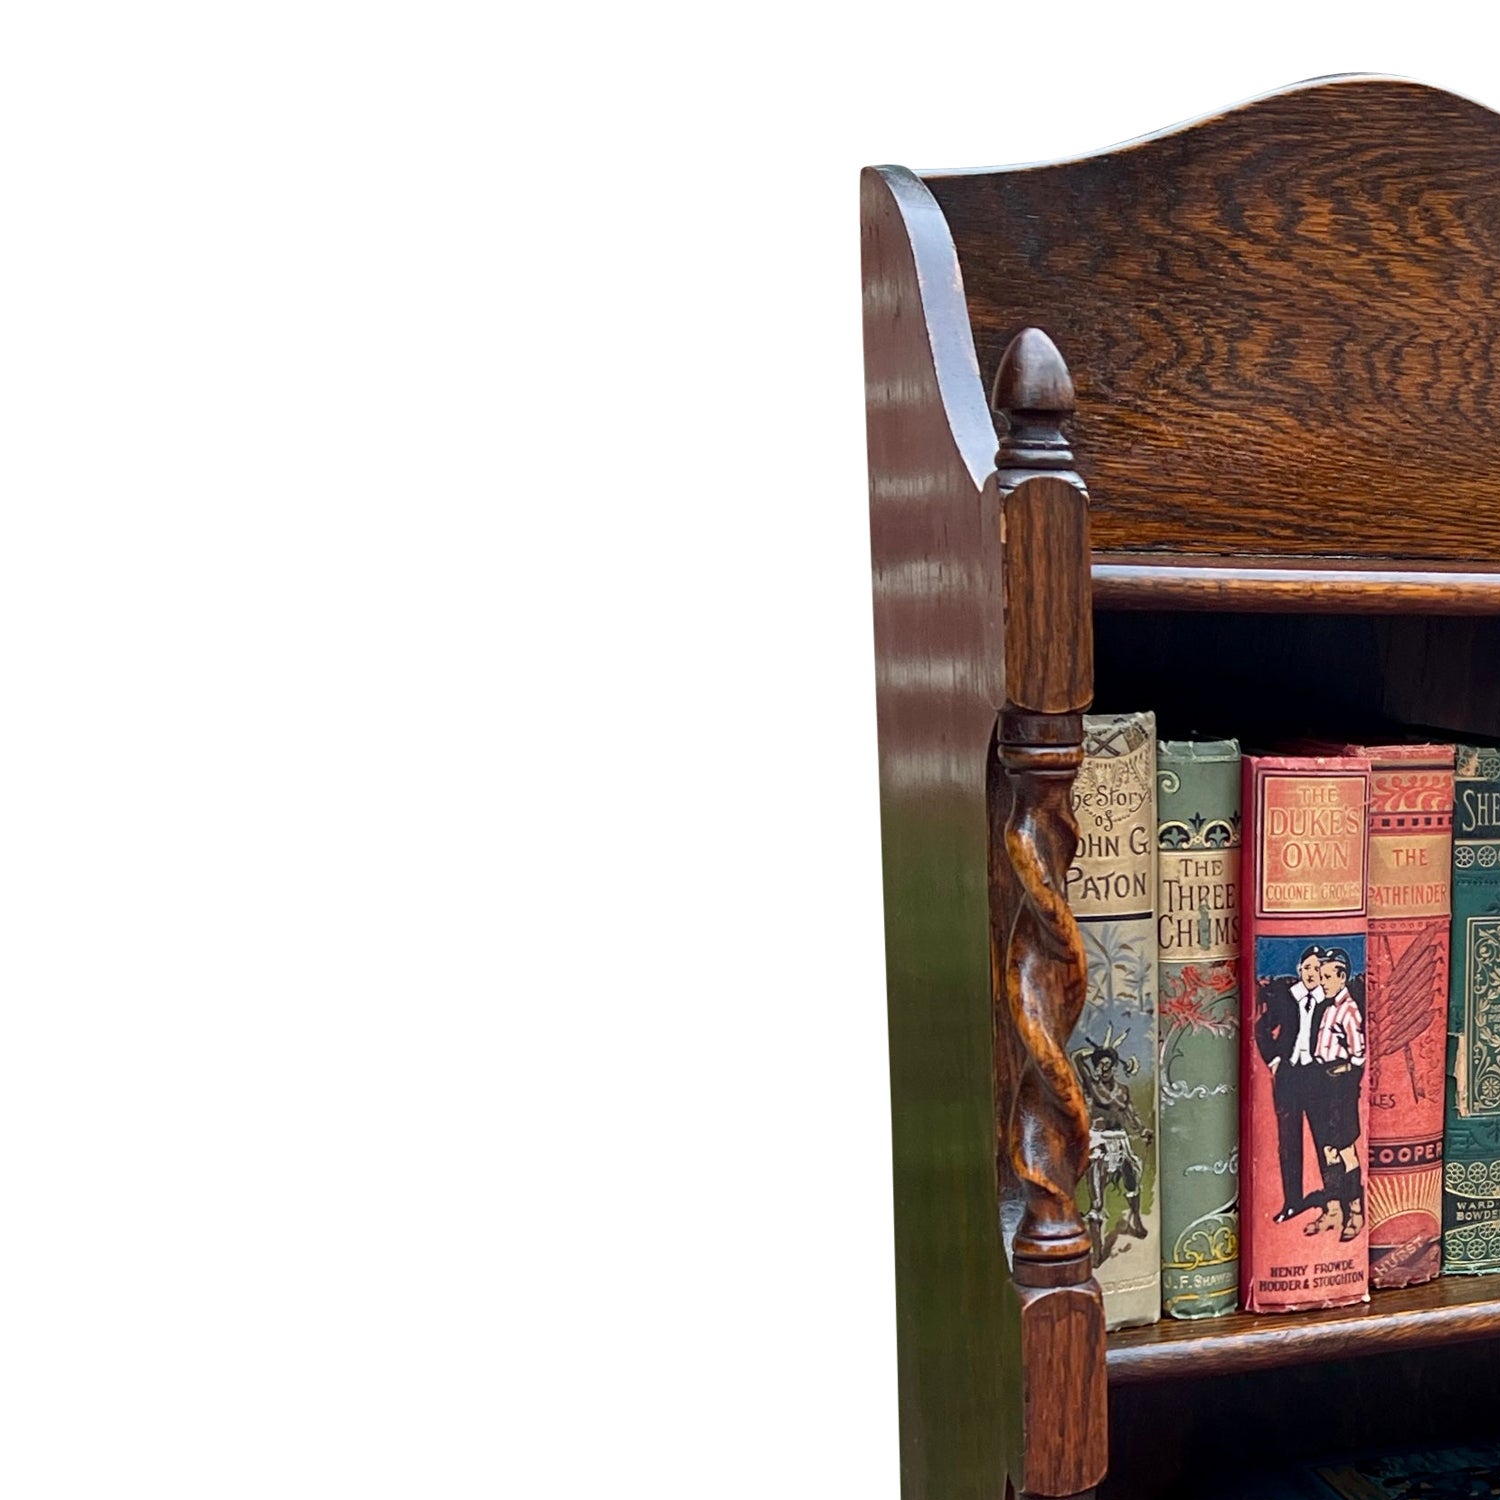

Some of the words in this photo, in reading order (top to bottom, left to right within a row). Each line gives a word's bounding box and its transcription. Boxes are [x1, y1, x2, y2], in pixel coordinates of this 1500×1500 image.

[1096, 785, 1149, 812] Story
[1299, 787, 1339, 804] THE
[1095, 810, 1113, 832] of
[1268, 805, 1360, 837] DUKE'S
[1074, 832, 1120, 858] OHN
[1281, 841, 1350, 870] OWN
[1180, 858, 1224, 878] THE
[1393, 848, 1428, 867] THE
[1063, 866, 1147, 901] PATON
[1266, 884, 1314, 901] COLONEL
[1163, 879, 1235, 913] THREE
[1368, 884, 1448, 906] PATHFINDER
[1369, 1142, 1443, 1164] COOPER
[1270, 1264, 1309, 1278] HENRY
[1314, 1260, 1355, 1276] FROWDE
[1259, 1277, 1301, 1292] HODDER
[1302, 1279, 1310, 1290] &
[1313, 1271, 1364, 1289] STOUGHTON
